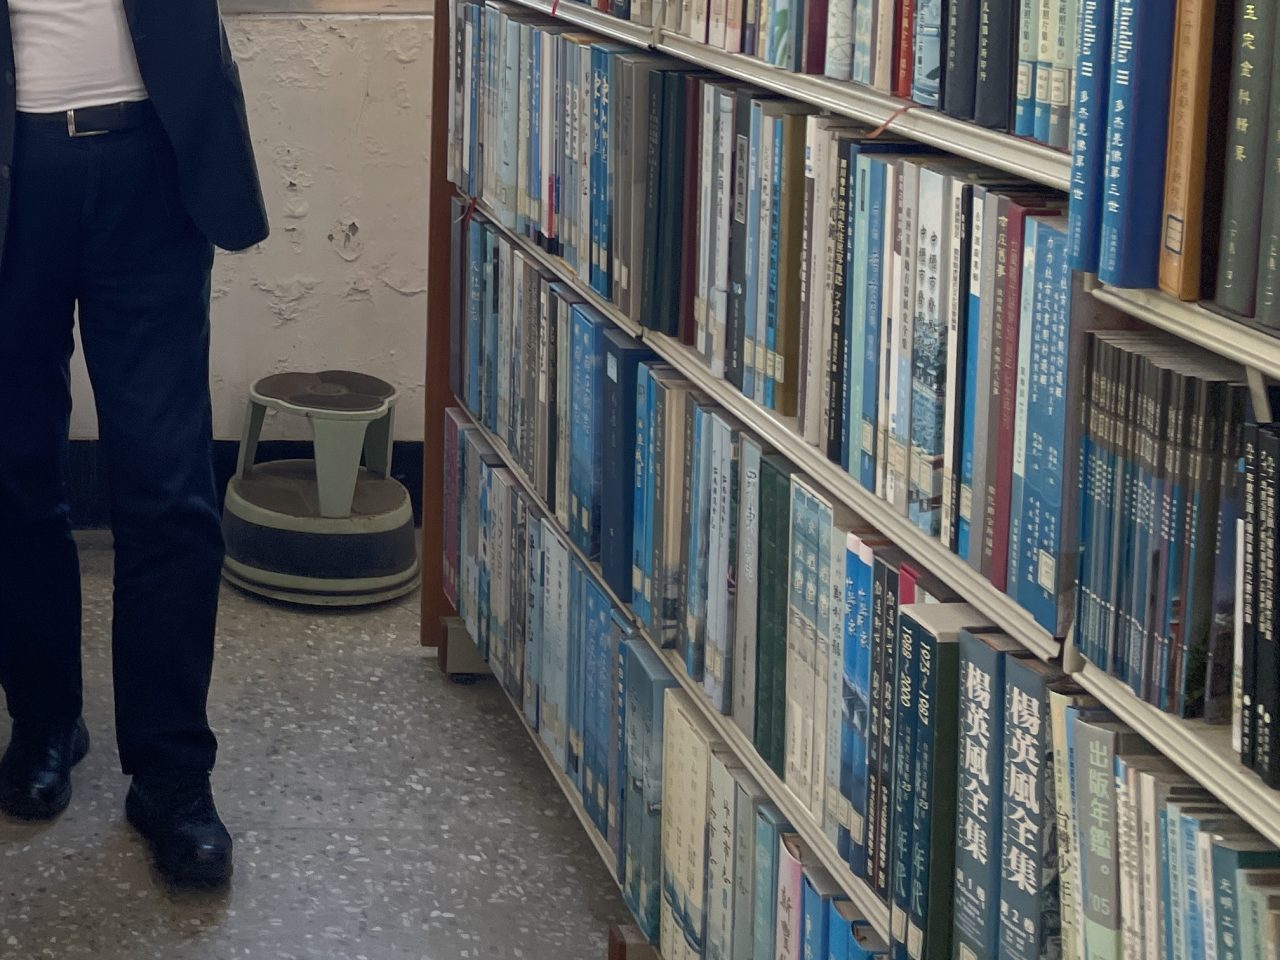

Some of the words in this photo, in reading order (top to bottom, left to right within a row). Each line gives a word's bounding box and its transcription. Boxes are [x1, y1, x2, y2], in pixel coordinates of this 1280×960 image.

[1081, 1, 1097, 55] Buddha
[1117, 7, 1133, 63] Buddha
[1081, 61, 1093, 77] III
[1115, 69, 1130, 85] III
[964, 661, 991, 865] 楊英風全集
[1007, 686, 1041, 896] 楊英風全集
[1089, 740, 1111, 859] 出版年鑑
